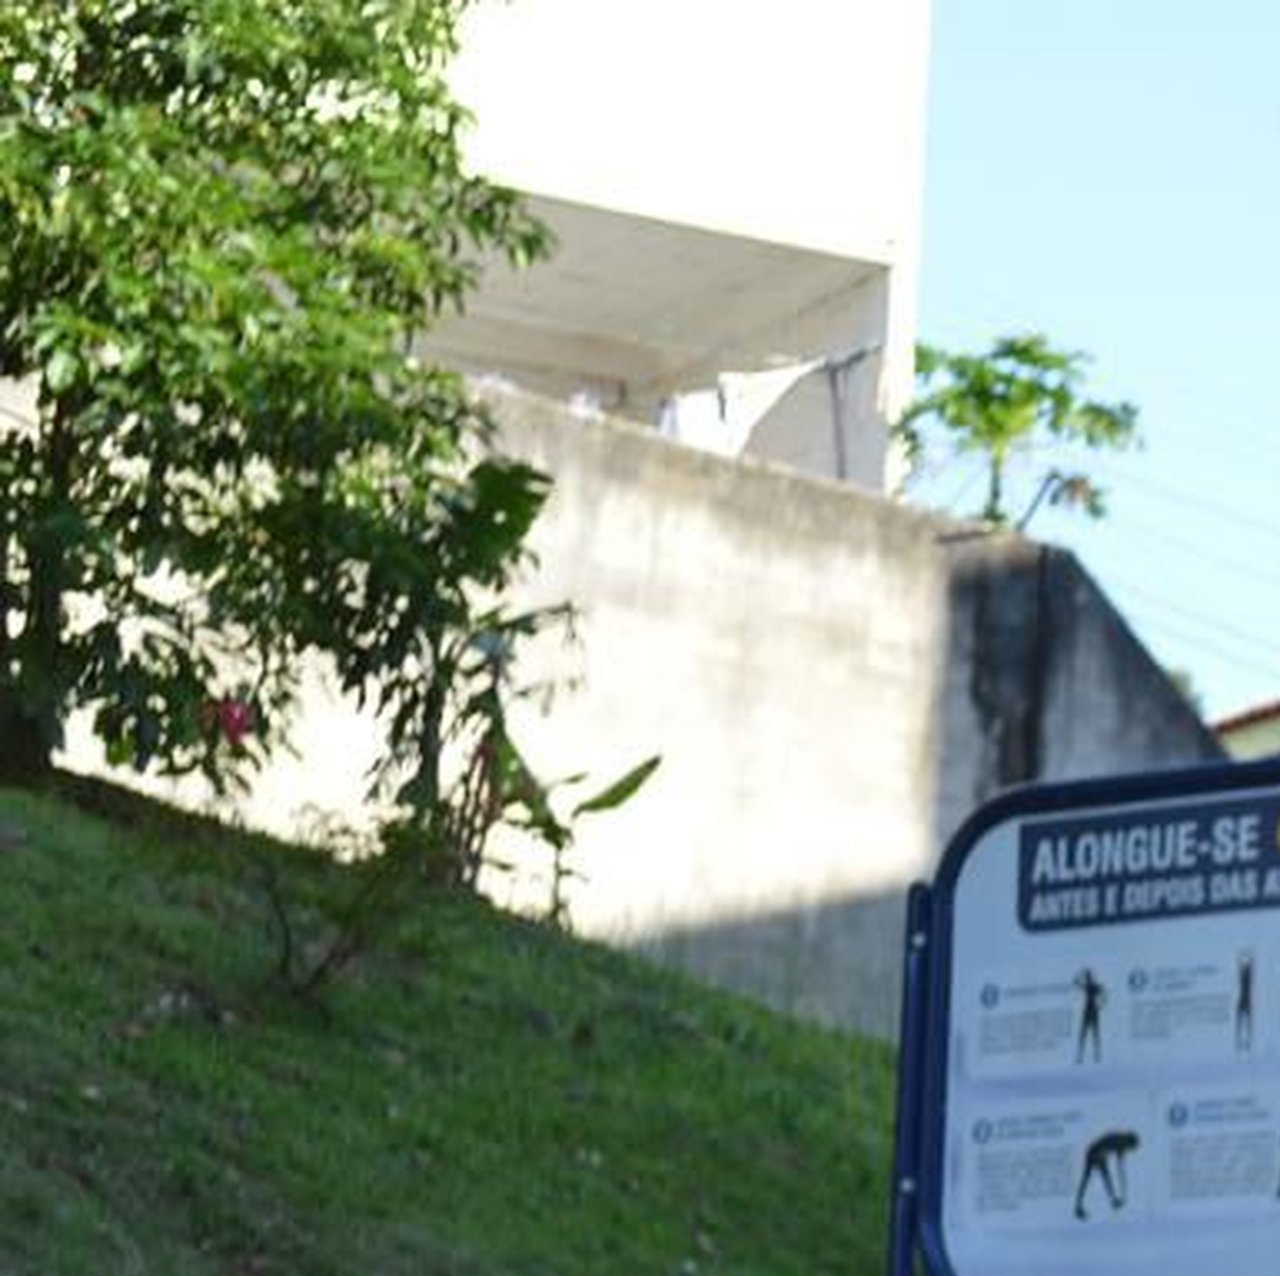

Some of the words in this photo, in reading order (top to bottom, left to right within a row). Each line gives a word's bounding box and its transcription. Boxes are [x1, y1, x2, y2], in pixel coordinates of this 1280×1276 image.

[1032, 815, 1259, 885] ALONGUE-SE
[1029, 887, 1099, 922] ANTES
[1105, 884, 1118, 917] E
[1121, 875, 1204, 914] DEPOIS
[1209, 869, 1259, 904] DAS
